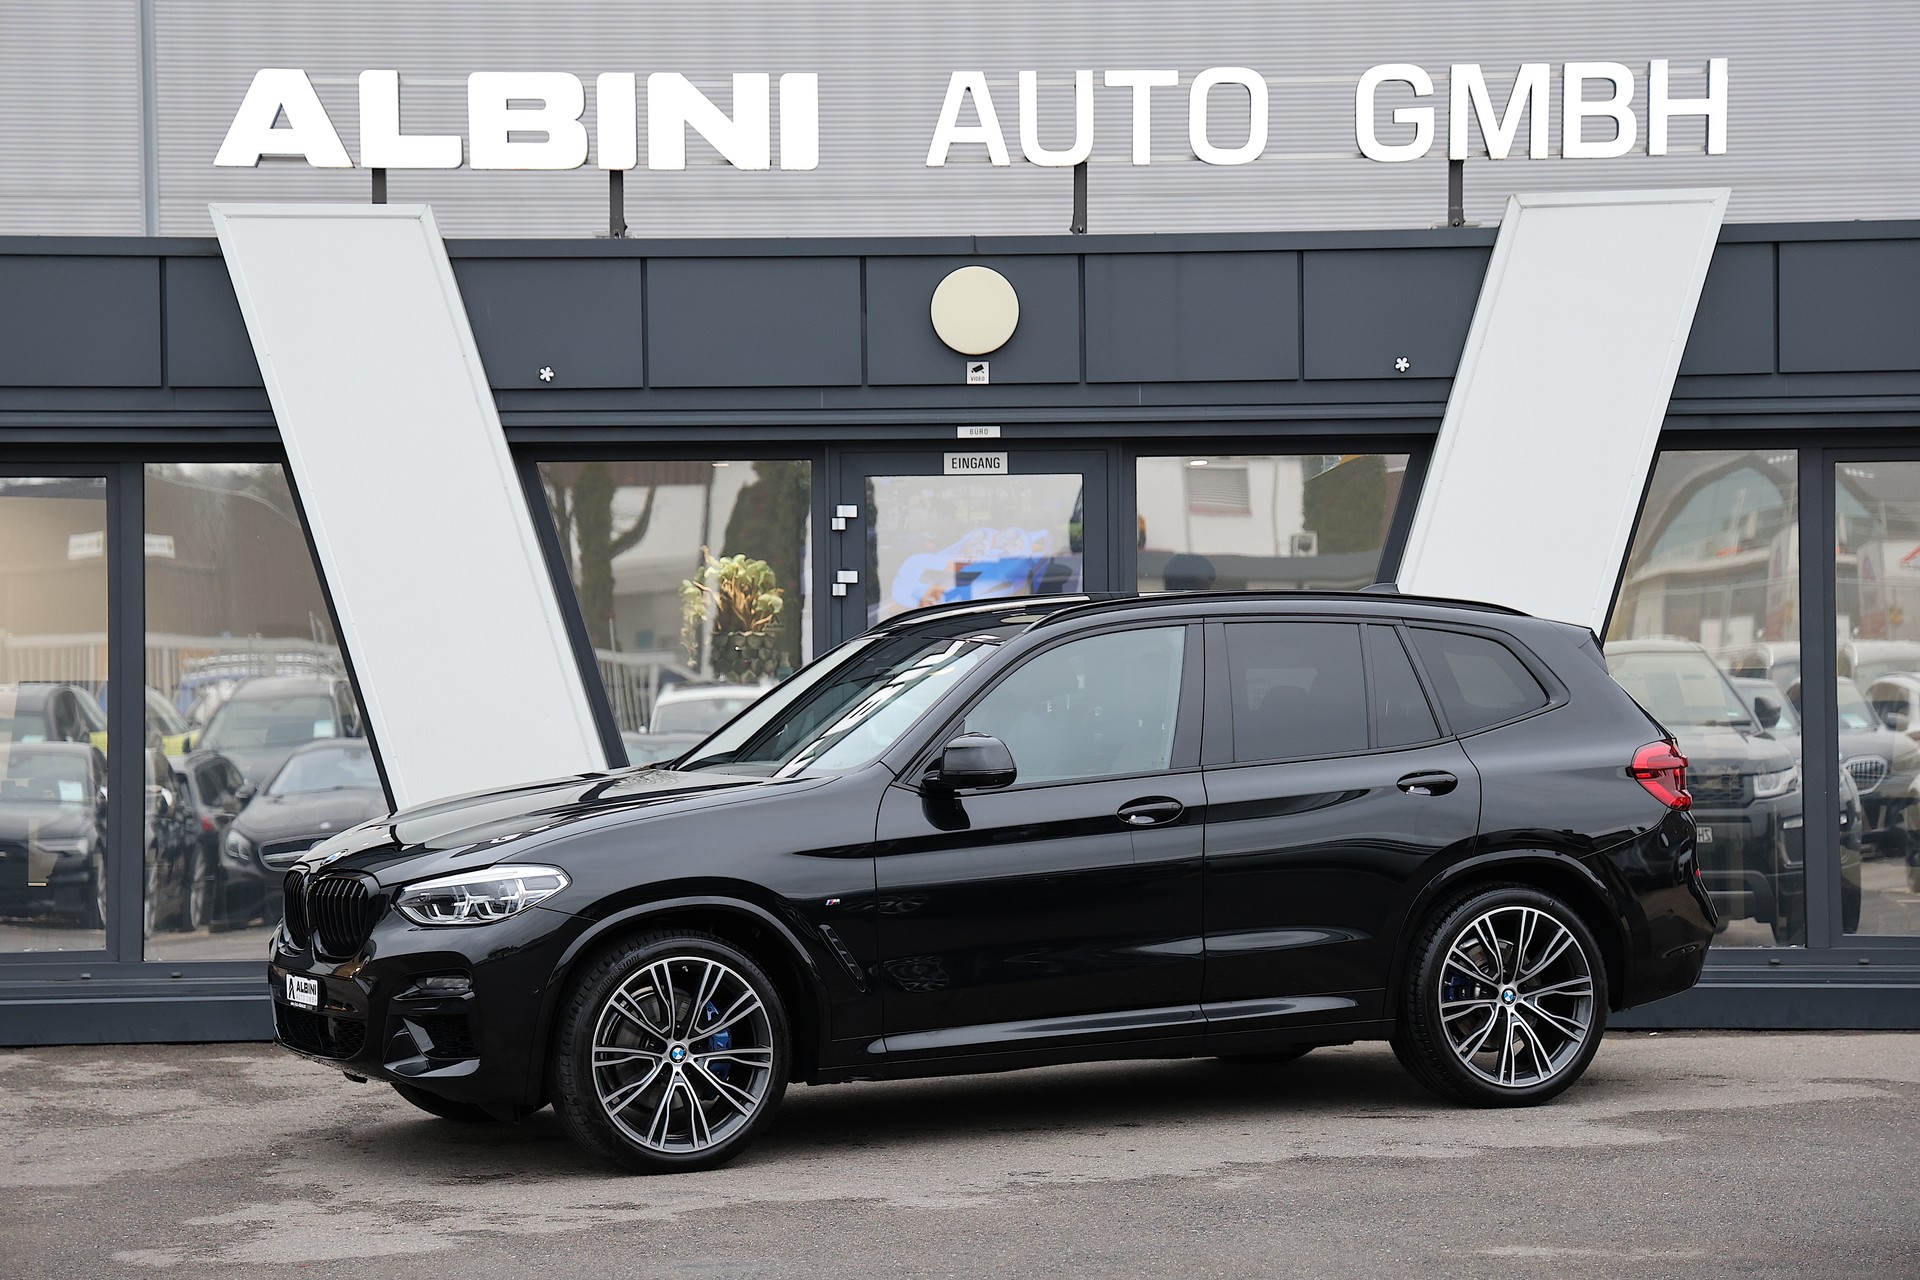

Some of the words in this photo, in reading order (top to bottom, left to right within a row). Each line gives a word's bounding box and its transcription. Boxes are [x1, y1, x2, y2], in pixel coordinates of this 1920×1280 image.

[212, 67, 820, 171] ALBINI
[925, 66, 1269, 167] AUTO
[1354, 57, 1728, 163] GMBH
[951, 457, 1001, 469] EINGANG
[296, 980, 317, 996] ALBINI
